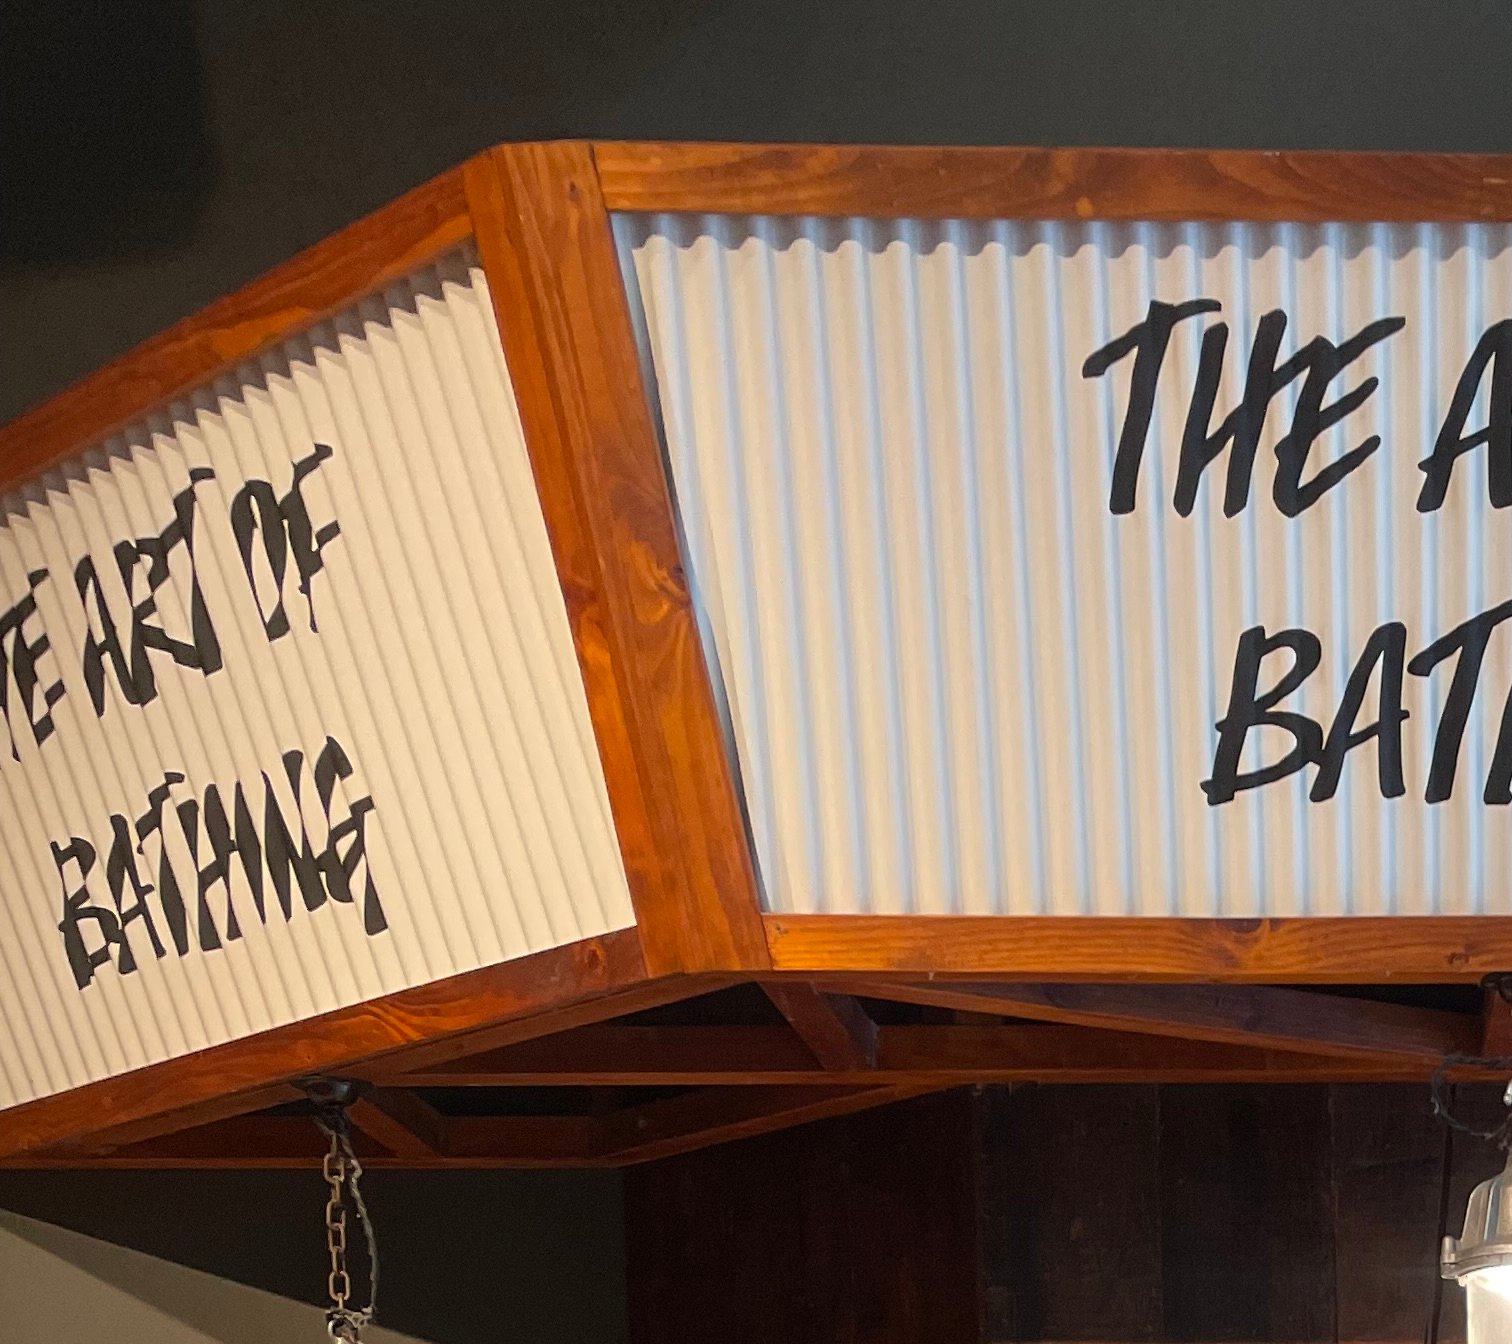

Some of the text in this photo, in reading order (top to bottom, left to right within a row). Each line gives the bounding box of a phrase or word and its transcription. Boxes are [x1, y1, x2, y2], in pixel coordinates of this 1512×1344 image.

[1082, 298, 1405, 518] THE
[75, 467, 223, 719] ART
[230, 443, 342, 642] OF
[51, 735, 389, 990] BATHING
